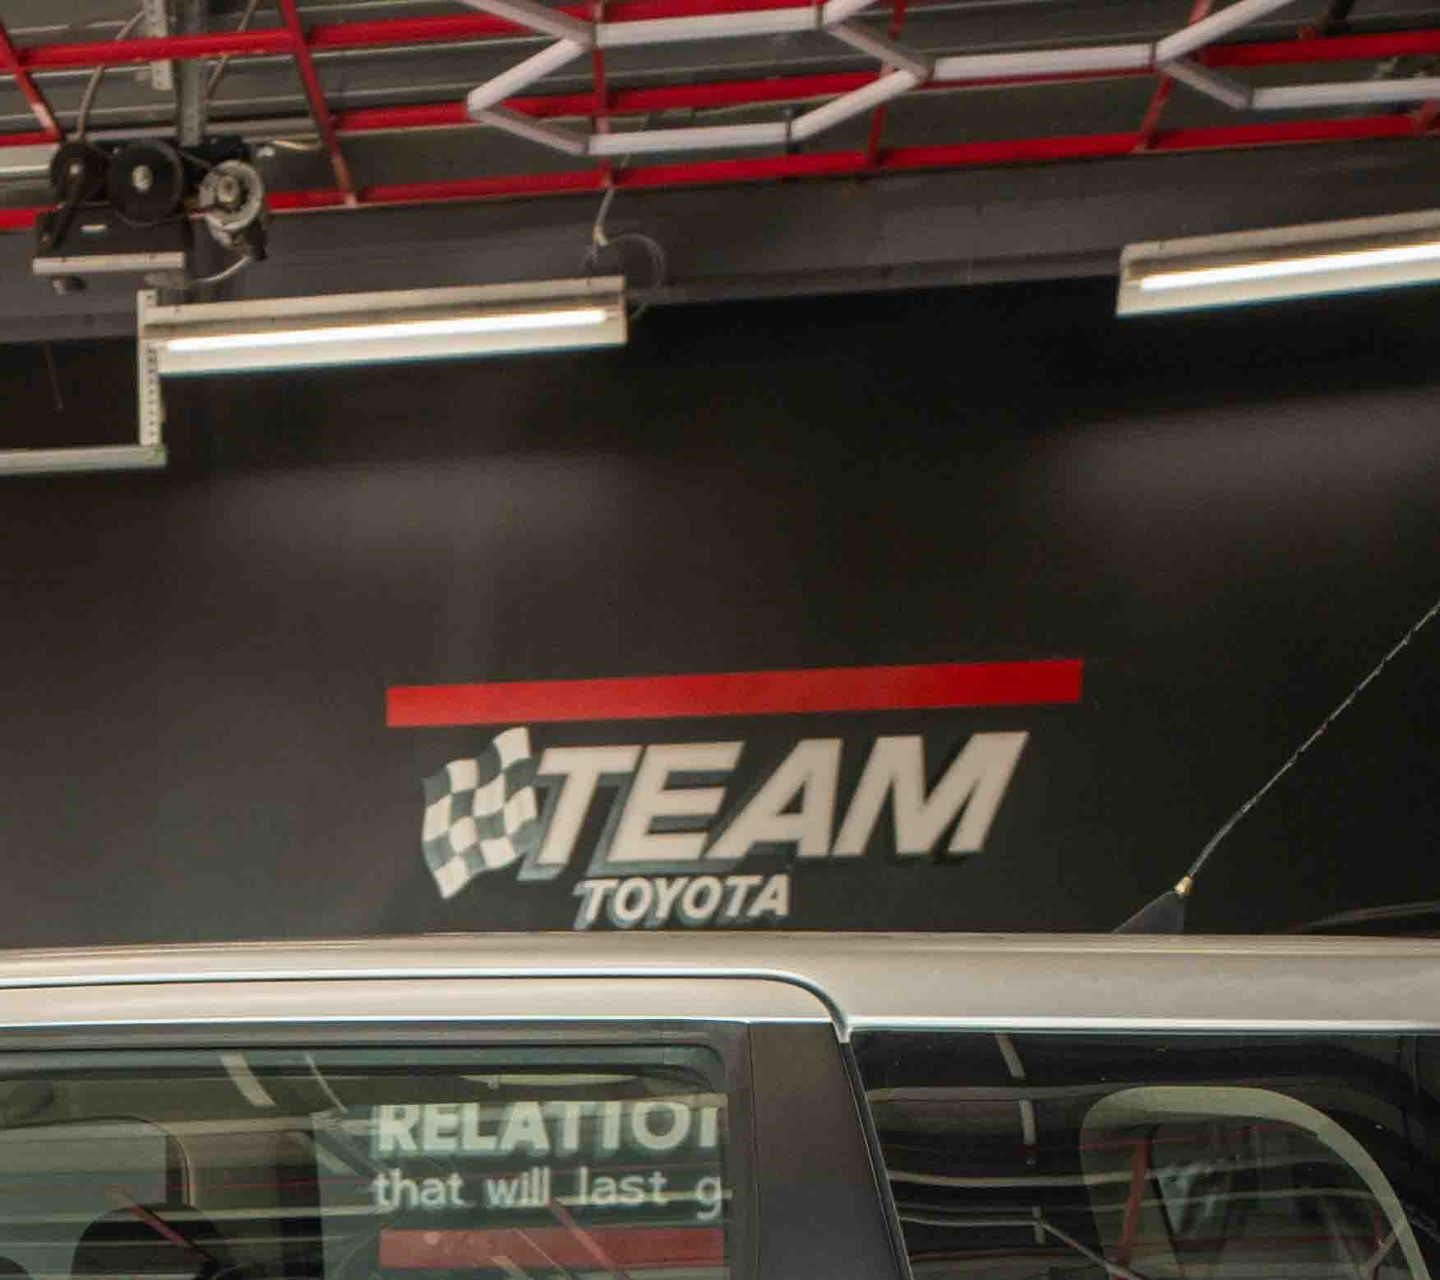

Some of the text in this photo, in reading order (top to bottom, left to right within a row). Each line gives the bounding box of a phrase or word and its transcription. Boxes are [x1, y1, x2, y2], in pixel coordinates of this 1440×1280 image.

[527, 730, 1030, 870] TEAM
[575, 874, 790, 928] TOYOTA
[374, 1167, 463, 1208] that
[484, 1166, 551, 1208] will
[579, 1165, 669, 1207] last
